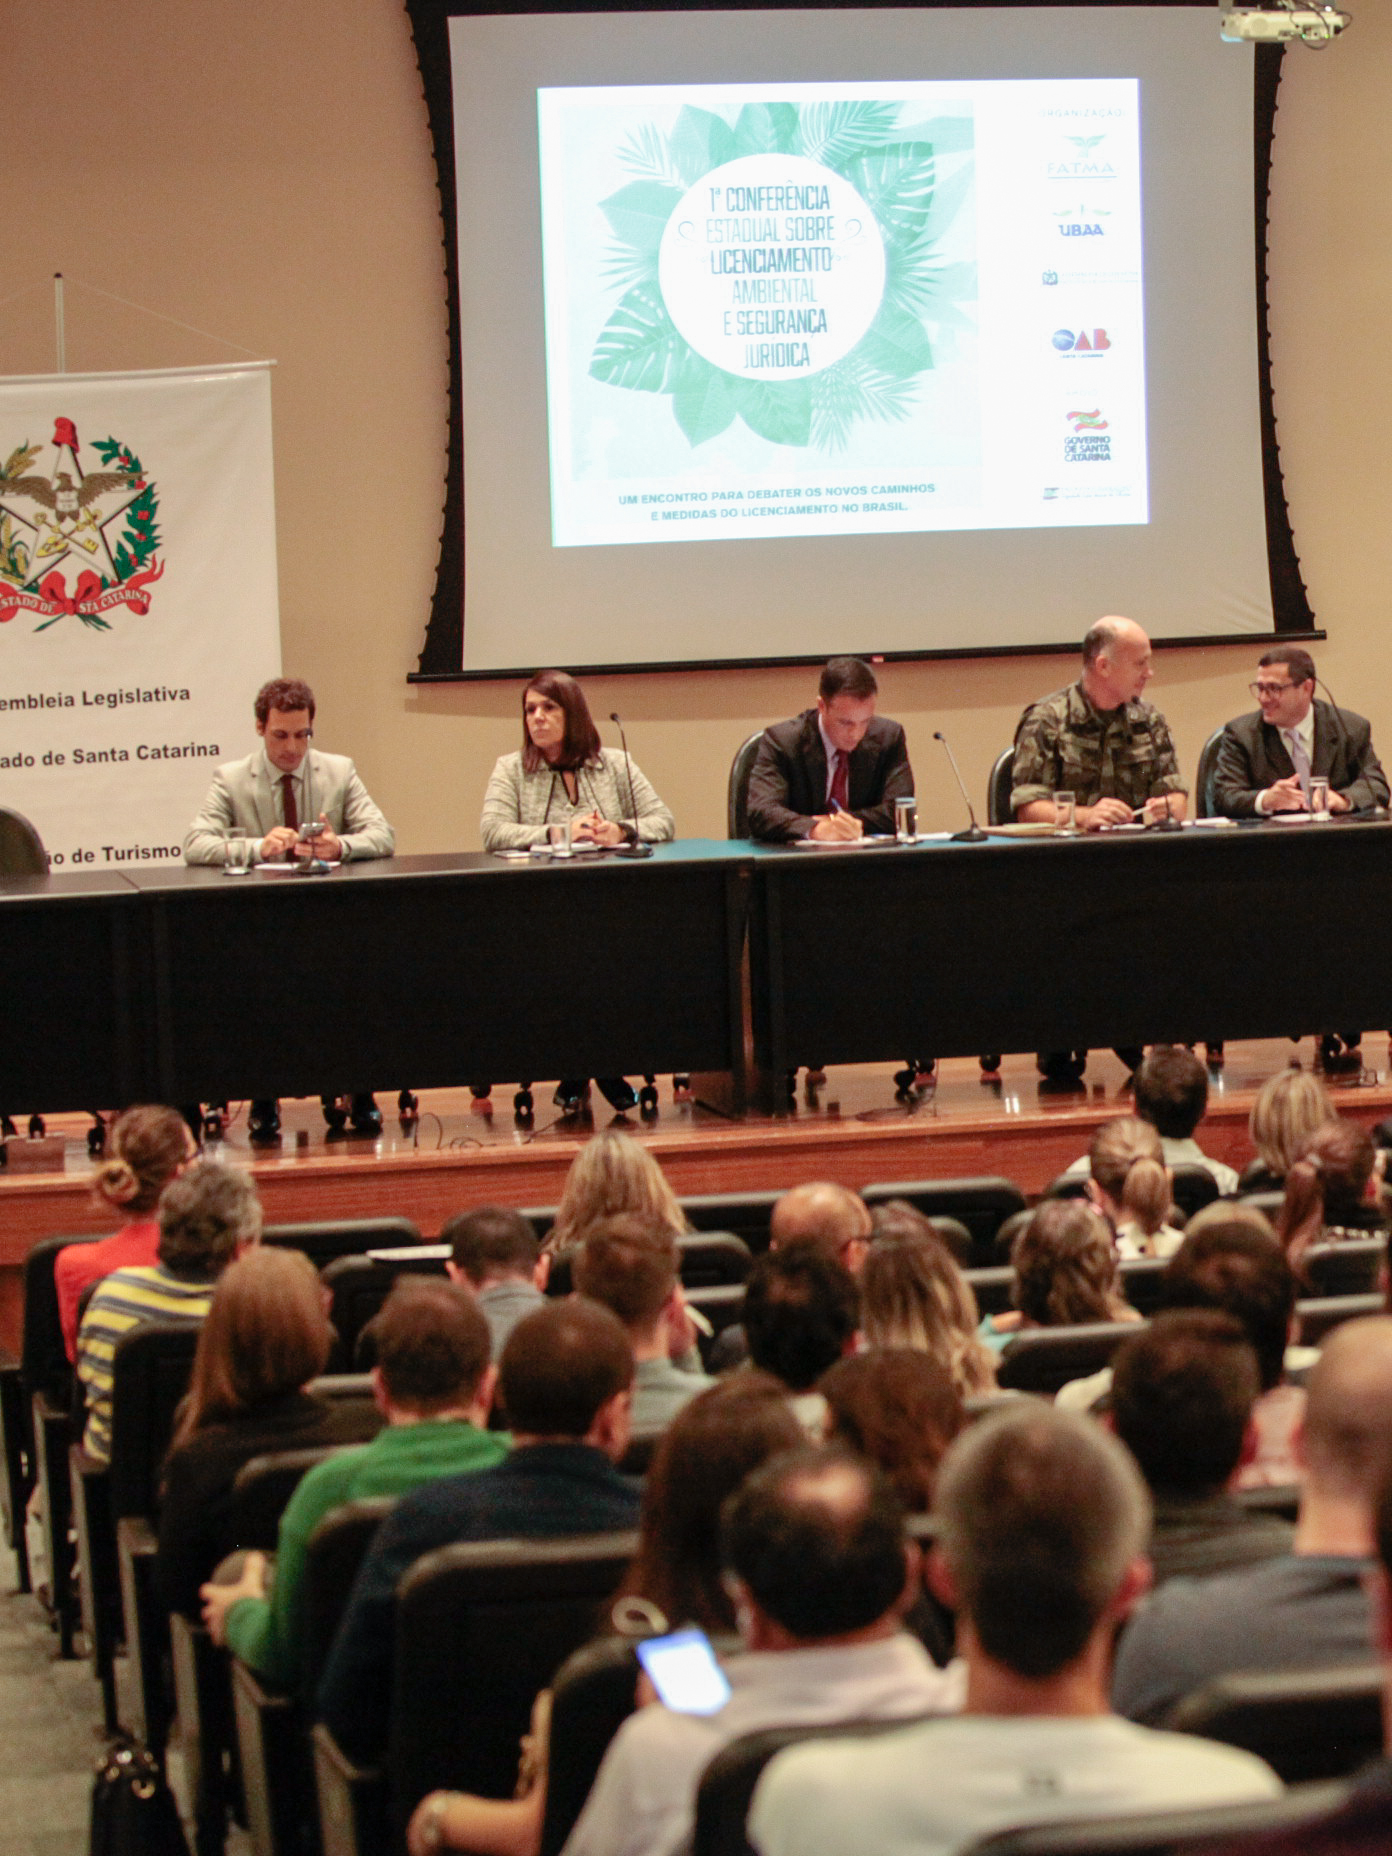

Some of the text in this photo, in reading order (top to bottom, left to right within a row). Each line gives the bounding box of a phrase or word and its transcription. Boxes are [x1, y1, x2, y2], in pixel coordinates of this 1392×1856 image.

[1048, 162, 1114, 174] FATMA
[726, 180, 830, 211] CONFERÊNCIA
[706, 216, 835, 243] ESTADUAL SOBRE
[1059, 224, 1104, 236] UBAA
[711, 247, 831, 274] LICENCIAMENTO
[732, 278, 818, 304] AMBIENTAL
[724, 309, 827, 337] E SEGURANÇA
[1065, 436, 1111, 444] GOVERNO
[1065, 444, 1110, 453] DE SANTA
[1065, 453, 1111, 462] CATARINA
[619, 484, 935, 505] UM ENCONTRO PARA DEBATER OS NOVOS CAMINHOS
[651, 501, 908, 521] E MEDIDAS DO LICENCIAMENTO NO BRASIL.
[40, 602, 54, 613] DE
[80, 602, 98, 613] STA
[100, 590, 147, 607] CATARINA
[82, 687, 190, 708] Legislativa
[0, 742, 220, 768] ado de Santa Catarina
[72, 848, 95, 863] de
[102, 844, 181, 862] Turismo
